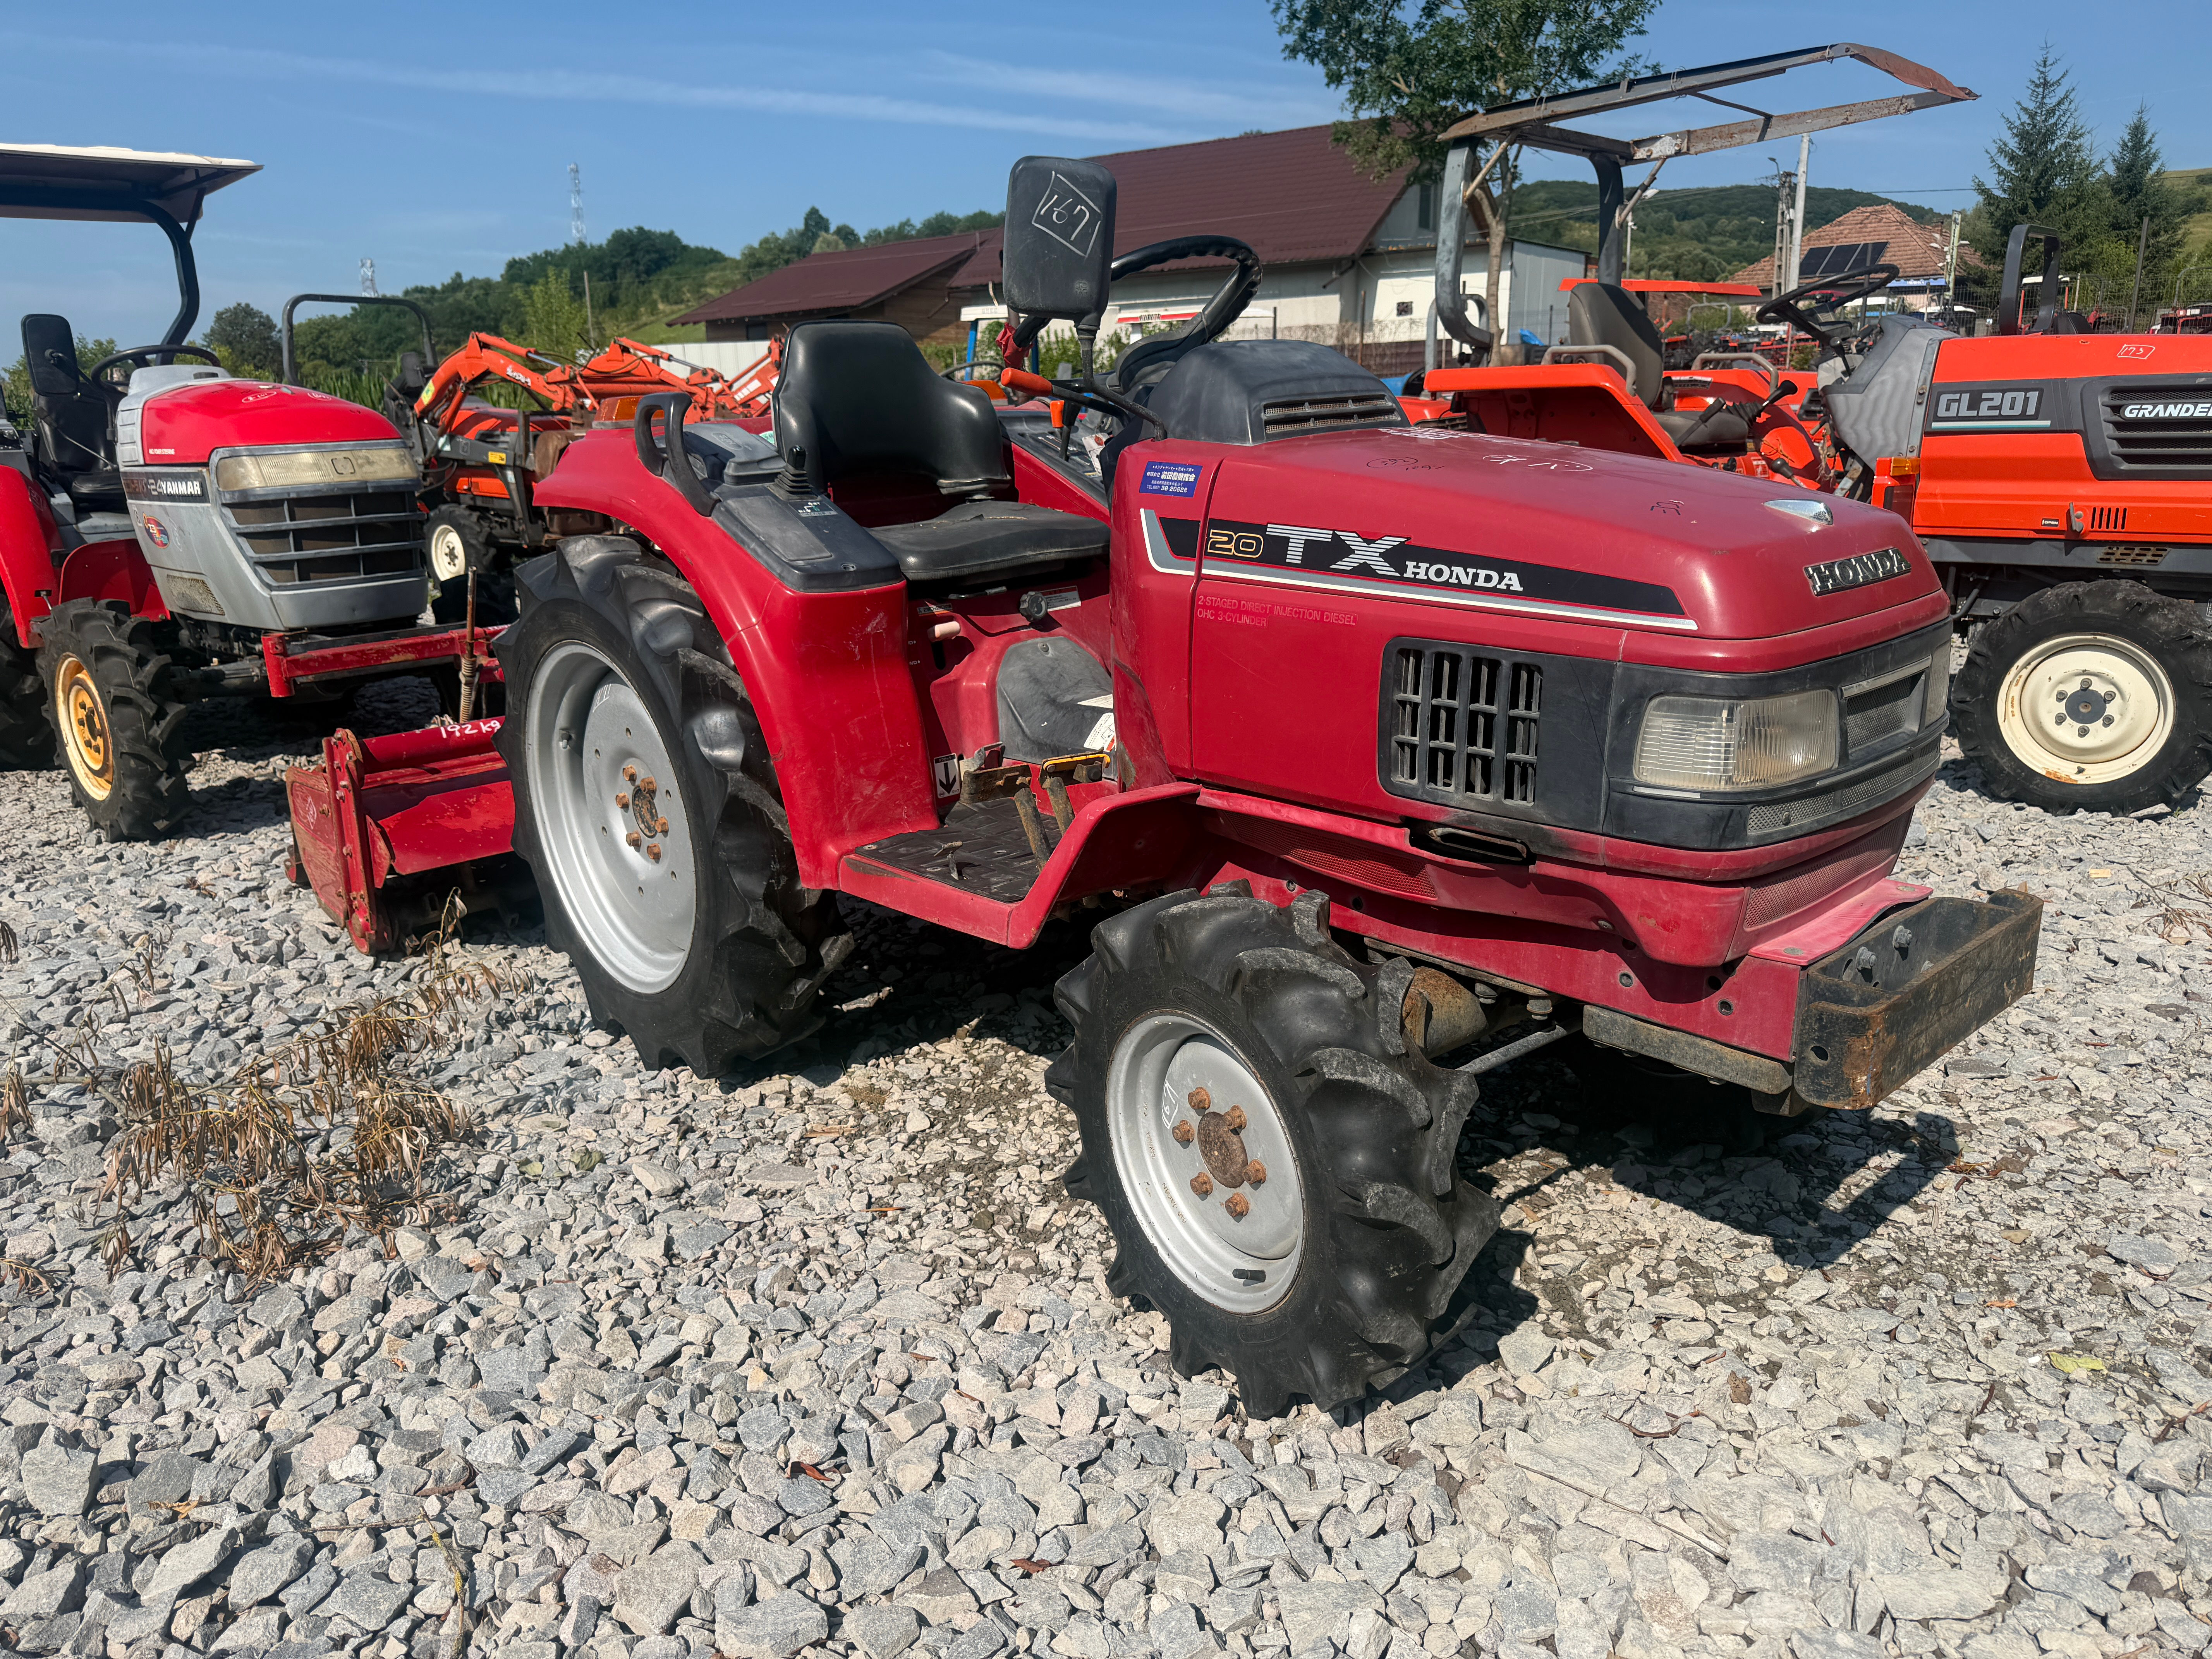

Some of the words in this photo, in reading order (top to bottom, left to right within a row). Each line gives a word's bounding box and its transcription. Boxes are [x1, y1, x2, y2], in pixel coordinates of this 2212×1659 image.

[1040, 195, 1090, 241] 167
[2120, 347, 2144, 356] 173
[1937, 391, 2039, 417] GL201
[161, 481, 201, 495] YANMAR
[1207, 529, 1264, 558] 20
[1266, 524, 1409, 577] TX
[1403, 561, 1524, 591] HONDA
[1805, 548, 1910, 592] HONDA
[1197, 608, 1215, 620] OHC
[1240, 601, 1272, 614] DIRECT
[1273, 605, 1321, 621] INJECTION
[1324, 611, 1356, 626] DIESEL
[440, 724, 478, 739] 192
